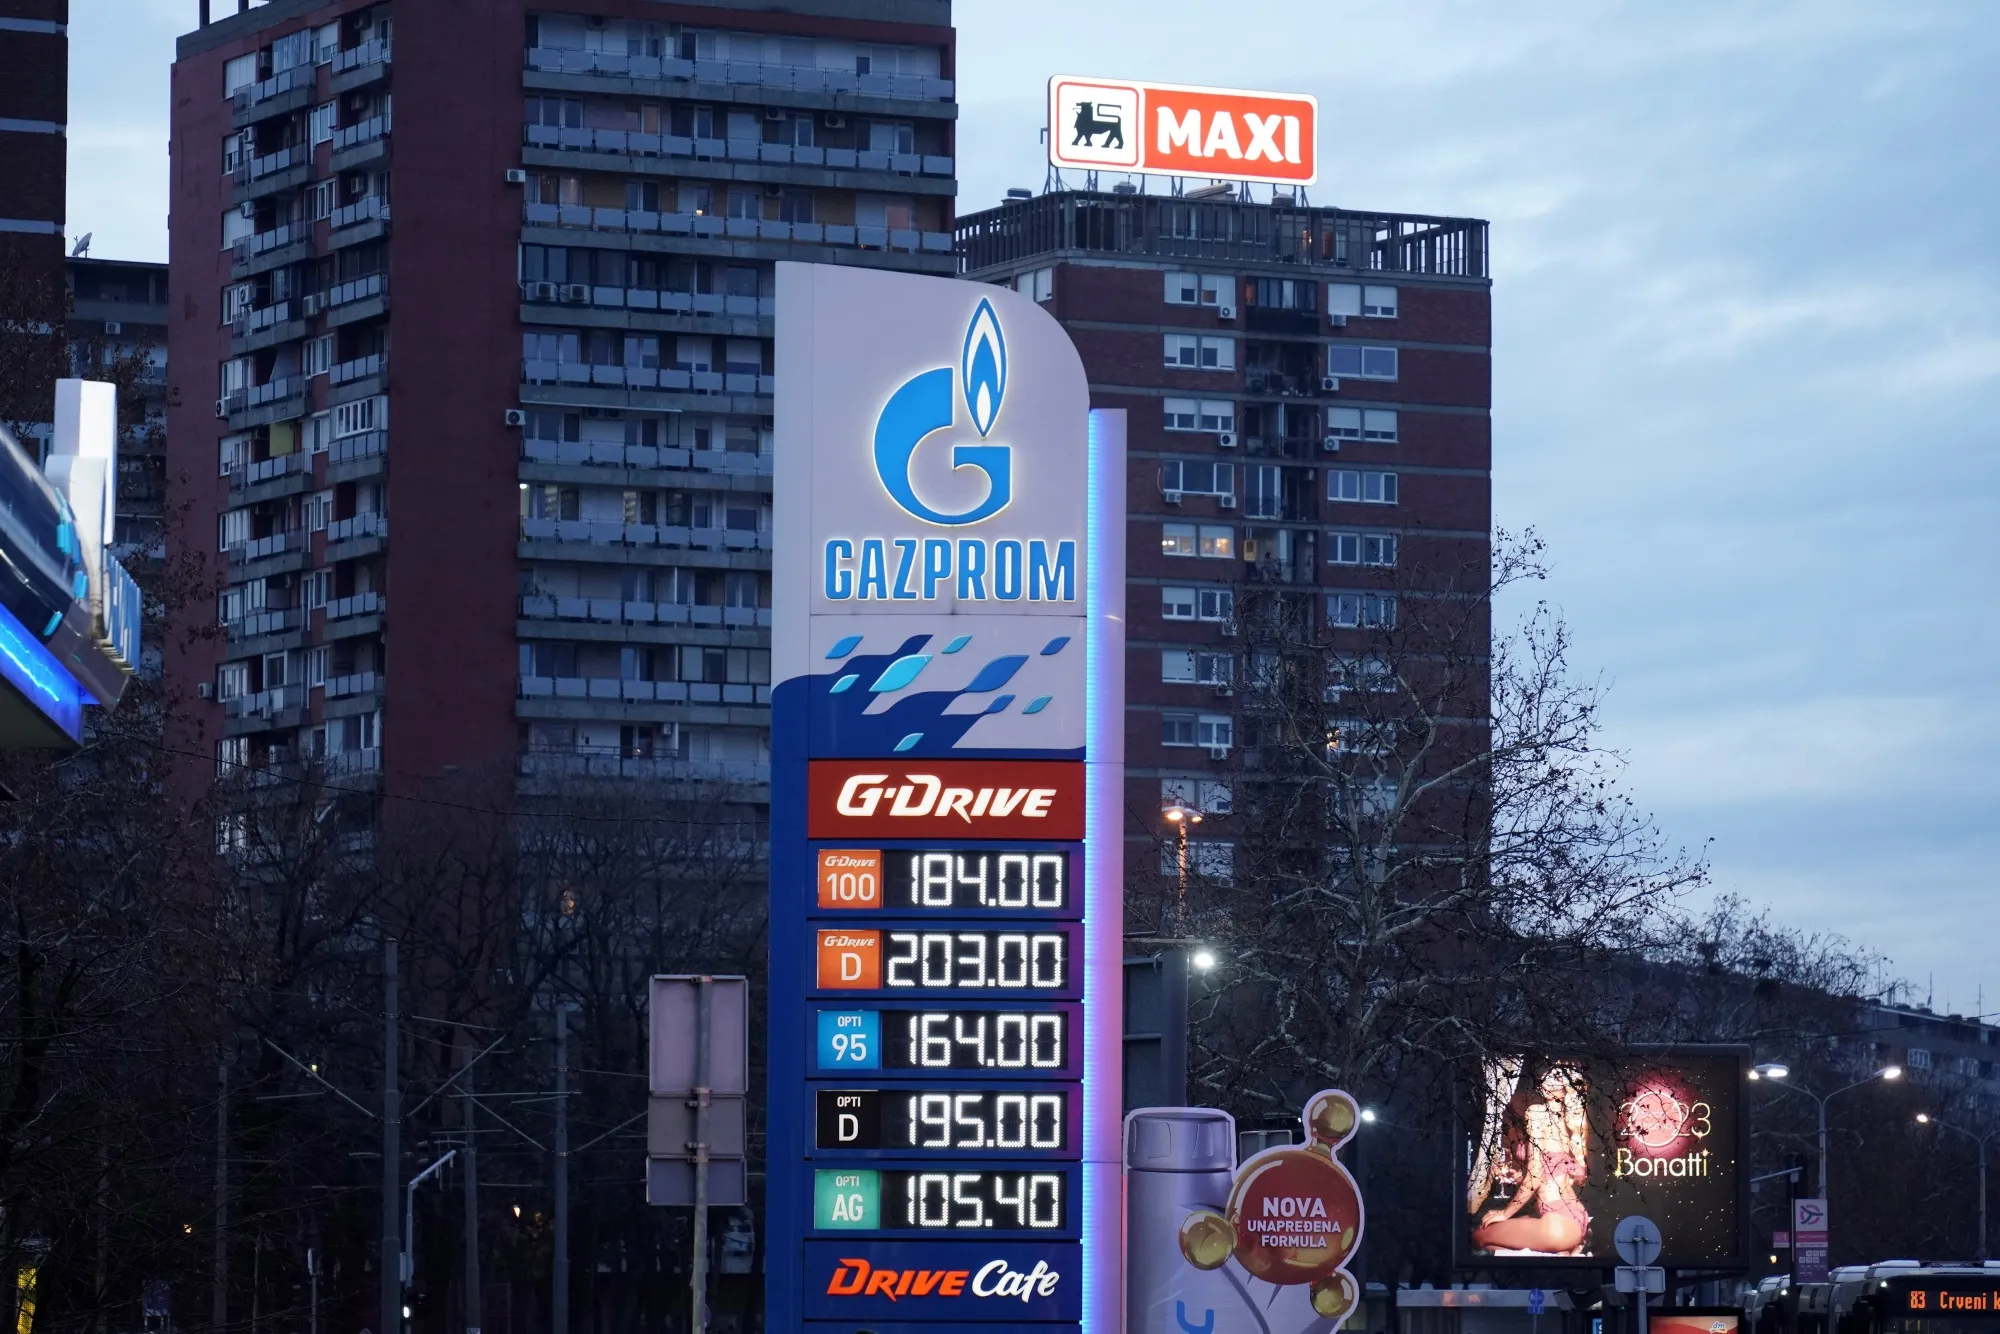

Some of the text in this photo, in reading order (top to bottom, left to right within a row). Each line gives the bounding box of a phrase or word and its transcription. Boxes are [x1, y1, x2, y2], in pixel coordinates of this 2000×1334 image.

[1156, 106, 1302, 164] MAXI
[824, 538, 1076, 602] GAZPROM
[826, 873, 875, 901] 100
[911, 854, 1063, 907] 184.00
[841, 952, 862, 981] D
[887, 934, 1063, 987] 203.00
[837, 1016, 861, 1027] OPTI
[832, 1034, 867, 1061] 95
[909, 1014, 1061, 1067] 164.00
[837, 1096, 861, 1108] OPTI
[838, 1114, 859, 1141] D
[908, 1094, 1061, 1147] 195.00
[1613, 1147, 1710, 1178] Bonatti
[835, 1176, 860, 1187] OPTI
[832, 1194, 863, 1222] AG
[907, 1174, 1060, 1228] 105.40
[1262, 1197, 1327, 1218] NOVA
[1247, 1220, 1341, 1233] UNAPREĐENA
[1261, 1235, 1327, 1248] FORMULA
[971, 1259, 1060, 1303] Cafe
[1910, 1291, 1926, 1309] 83
[1940, 1291, 1987, 1310] Crveni
[1713, 1321, 1725, 1329] dm
